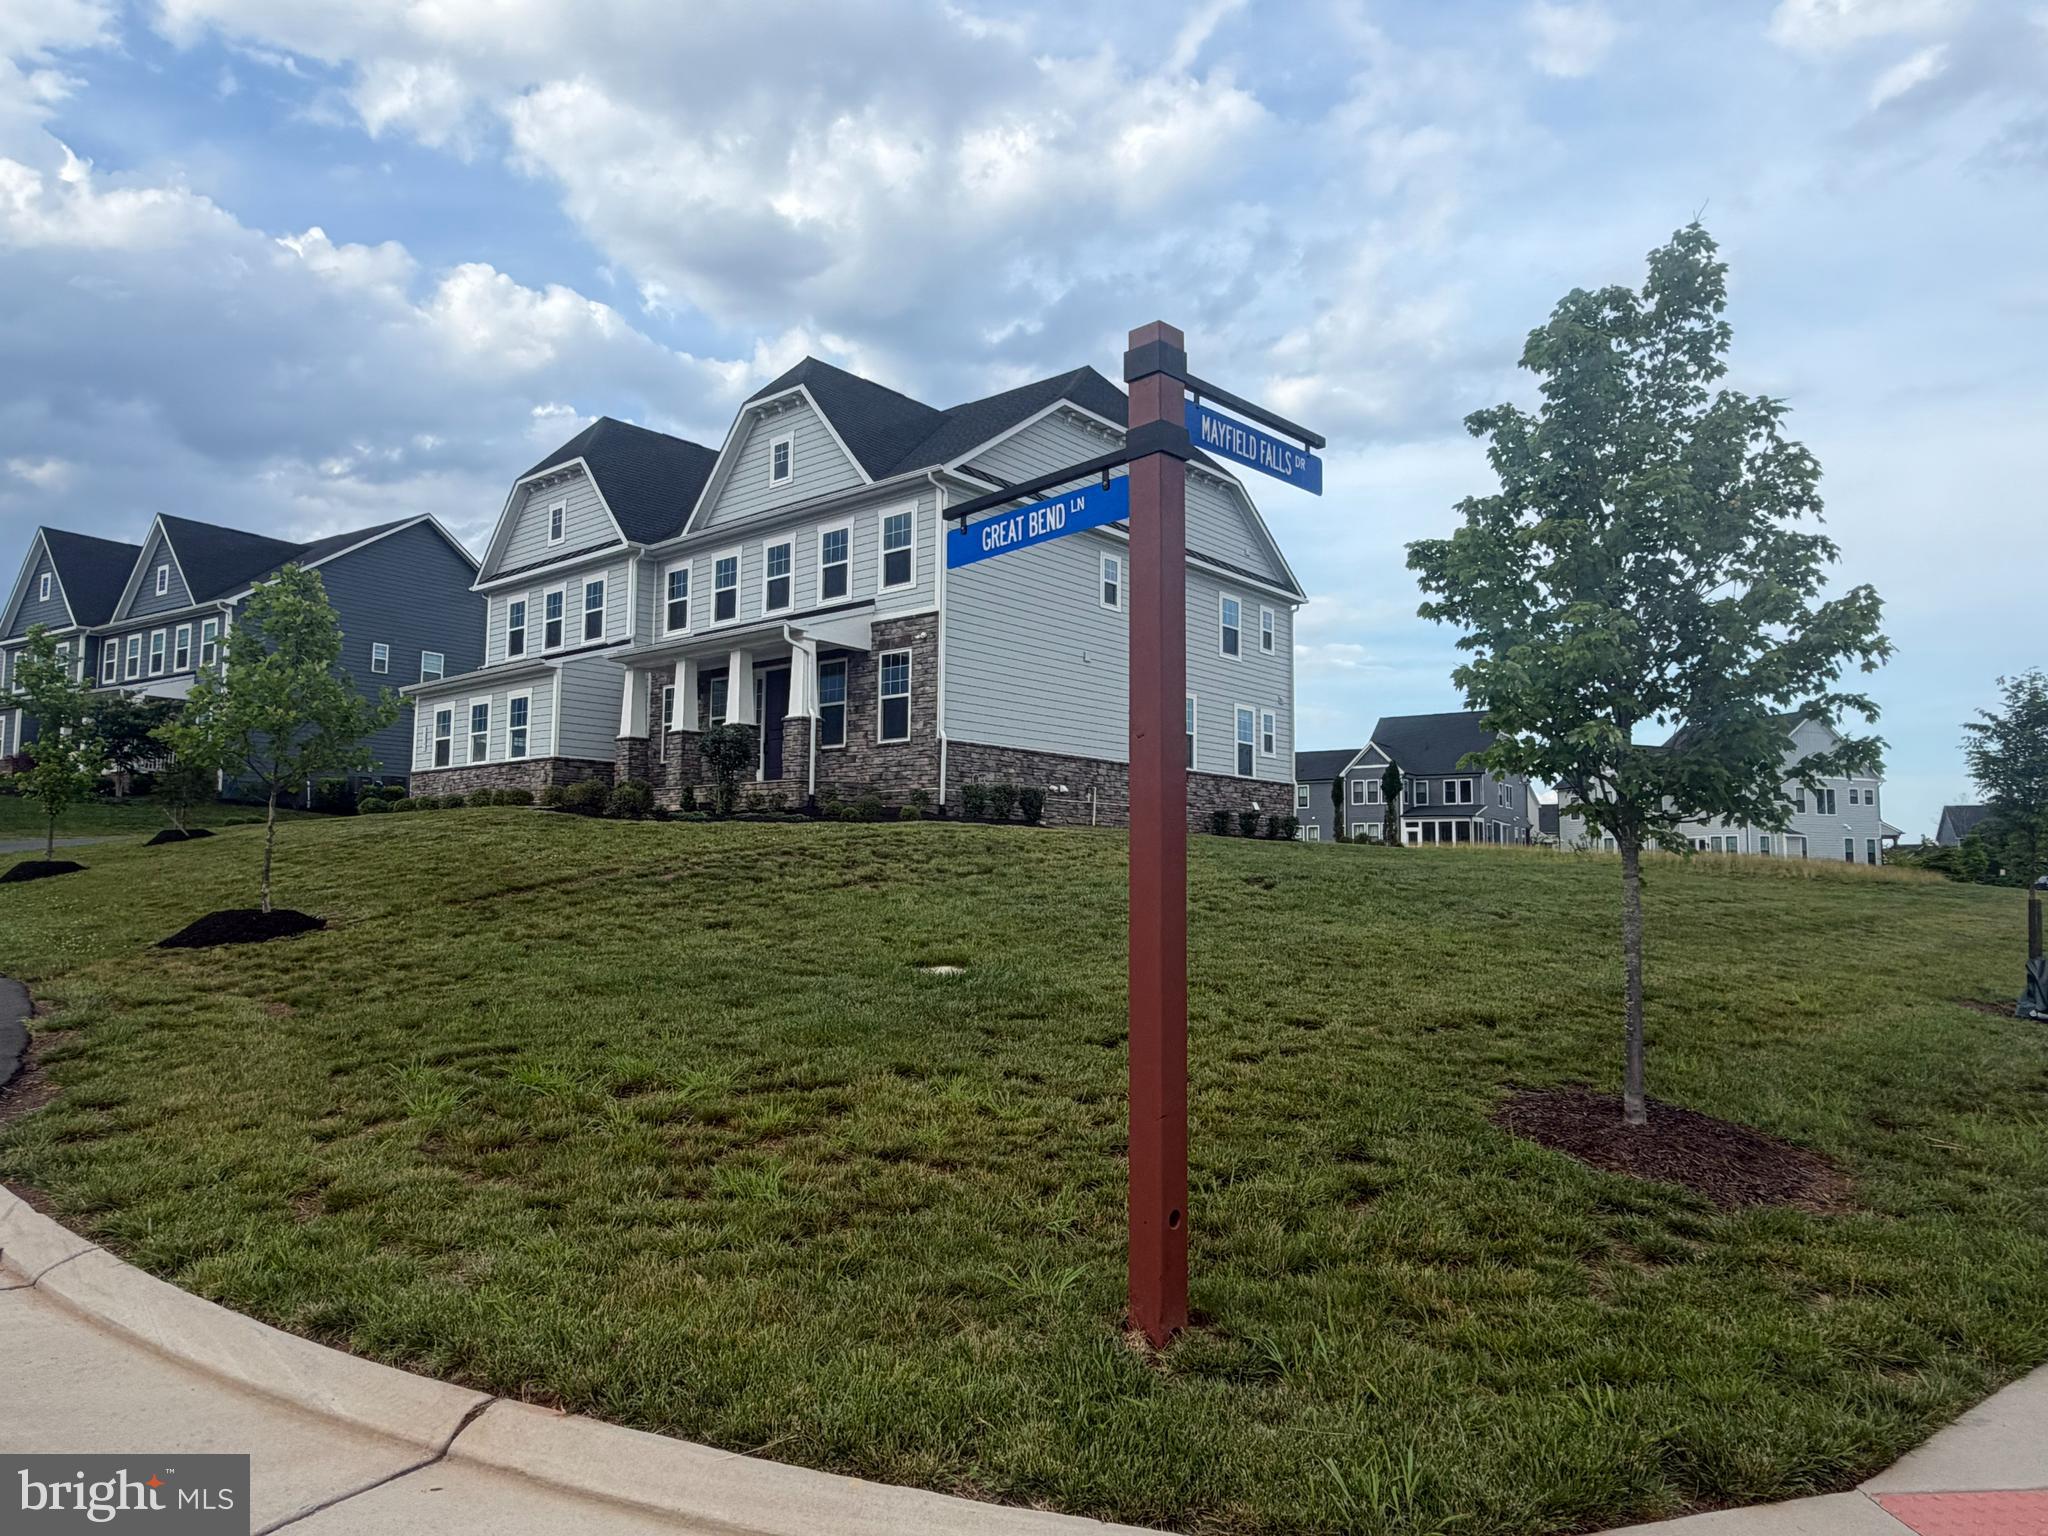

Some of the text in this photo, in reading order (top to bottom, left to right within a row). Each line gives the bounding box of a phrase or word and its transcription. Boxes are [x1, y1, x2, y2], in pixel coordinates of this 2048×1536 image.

[1201, 414, 1306, 476] MAYFIELD FALLS DR
[982, 496, 1085, 551] GREAT BEND LN
